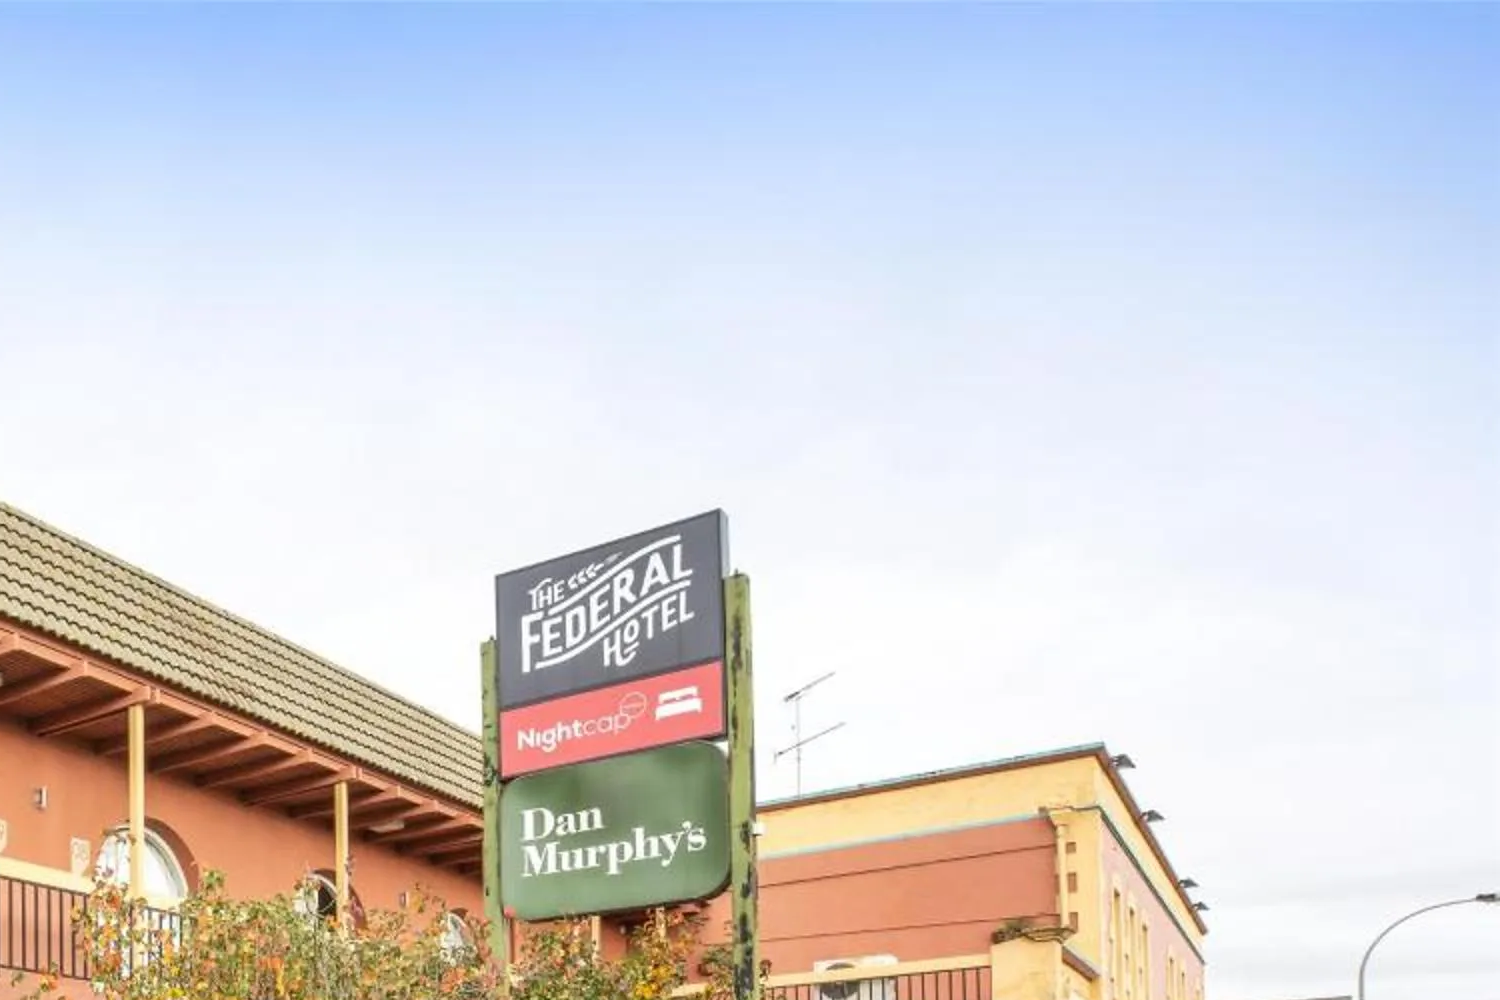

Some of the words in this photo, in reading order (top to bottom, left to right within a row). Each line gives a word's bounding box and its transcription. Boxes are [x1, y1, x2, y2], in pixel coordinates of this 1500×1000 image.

[521, 544, 693, 673] FEDERAL
[528, 577, 565, 611] THE
[603, 591, 695, 667] HOTEL
[517, 713, 631, 753] Nightcap
[522, 805, 605, 843] Dan
[522, 821, 707, 877] Murphy's
